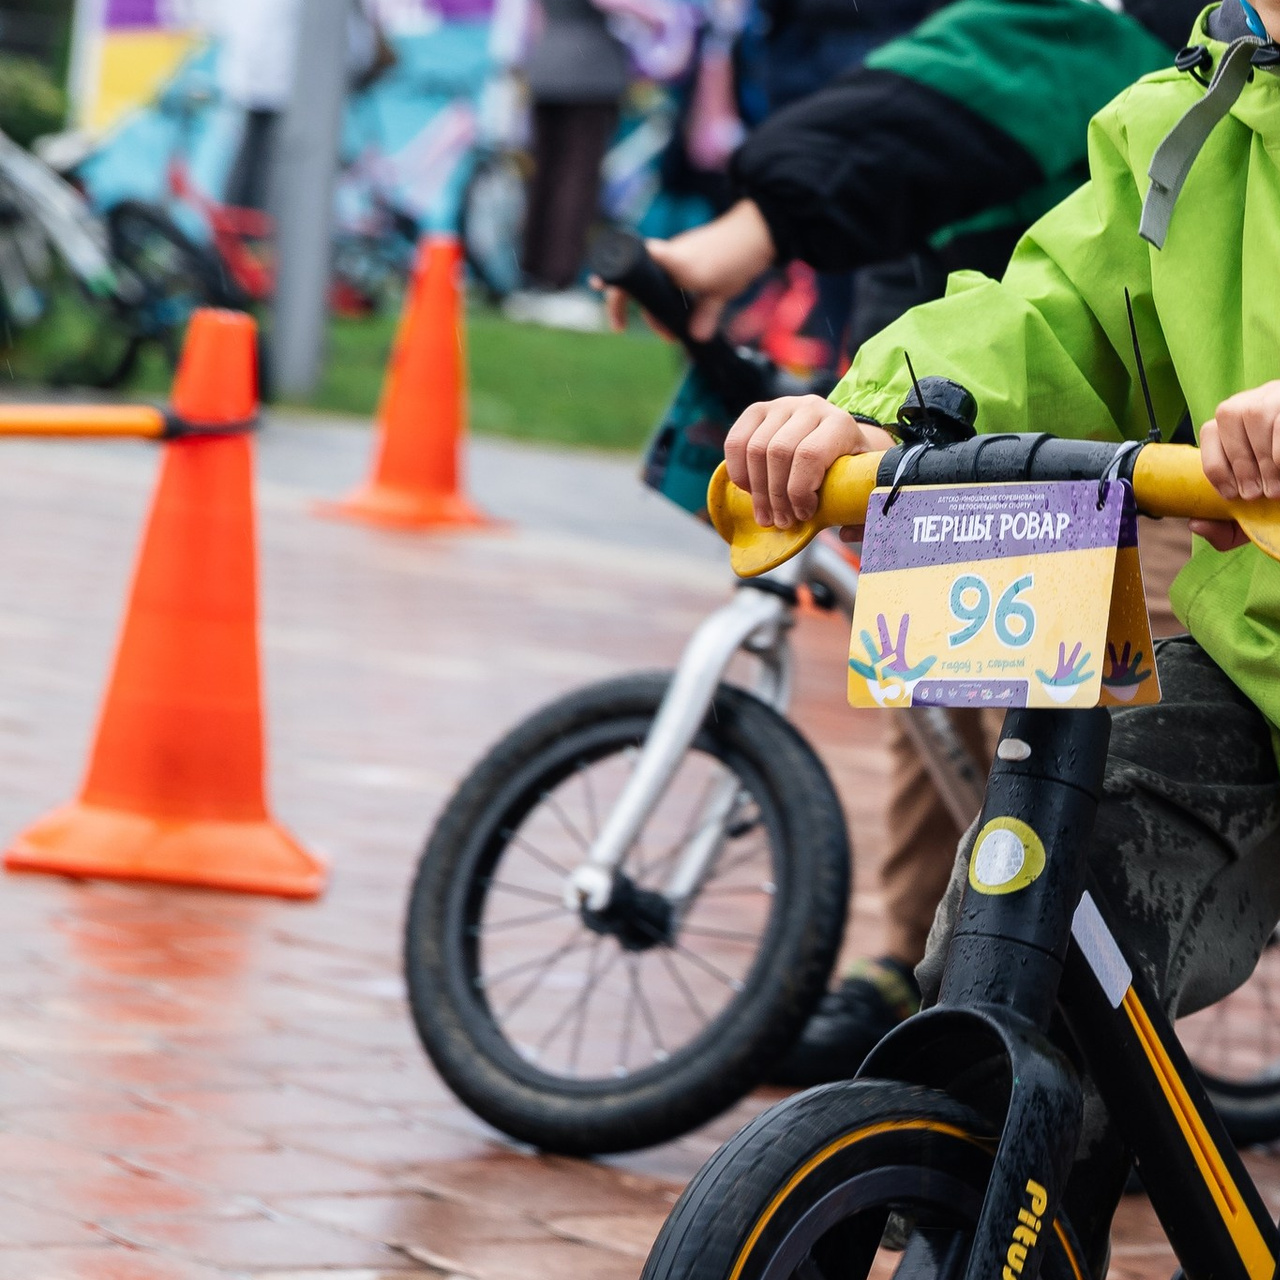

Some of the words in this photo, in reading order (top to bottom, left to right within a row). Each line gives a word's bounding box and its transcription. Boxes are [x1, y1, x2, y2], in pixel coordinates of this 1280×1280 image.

[912, 514, 994, 543] ПЕРШЫ
[999, 511, 1070, 541] РОВАР
[948, 573, 1037, 649] 96
